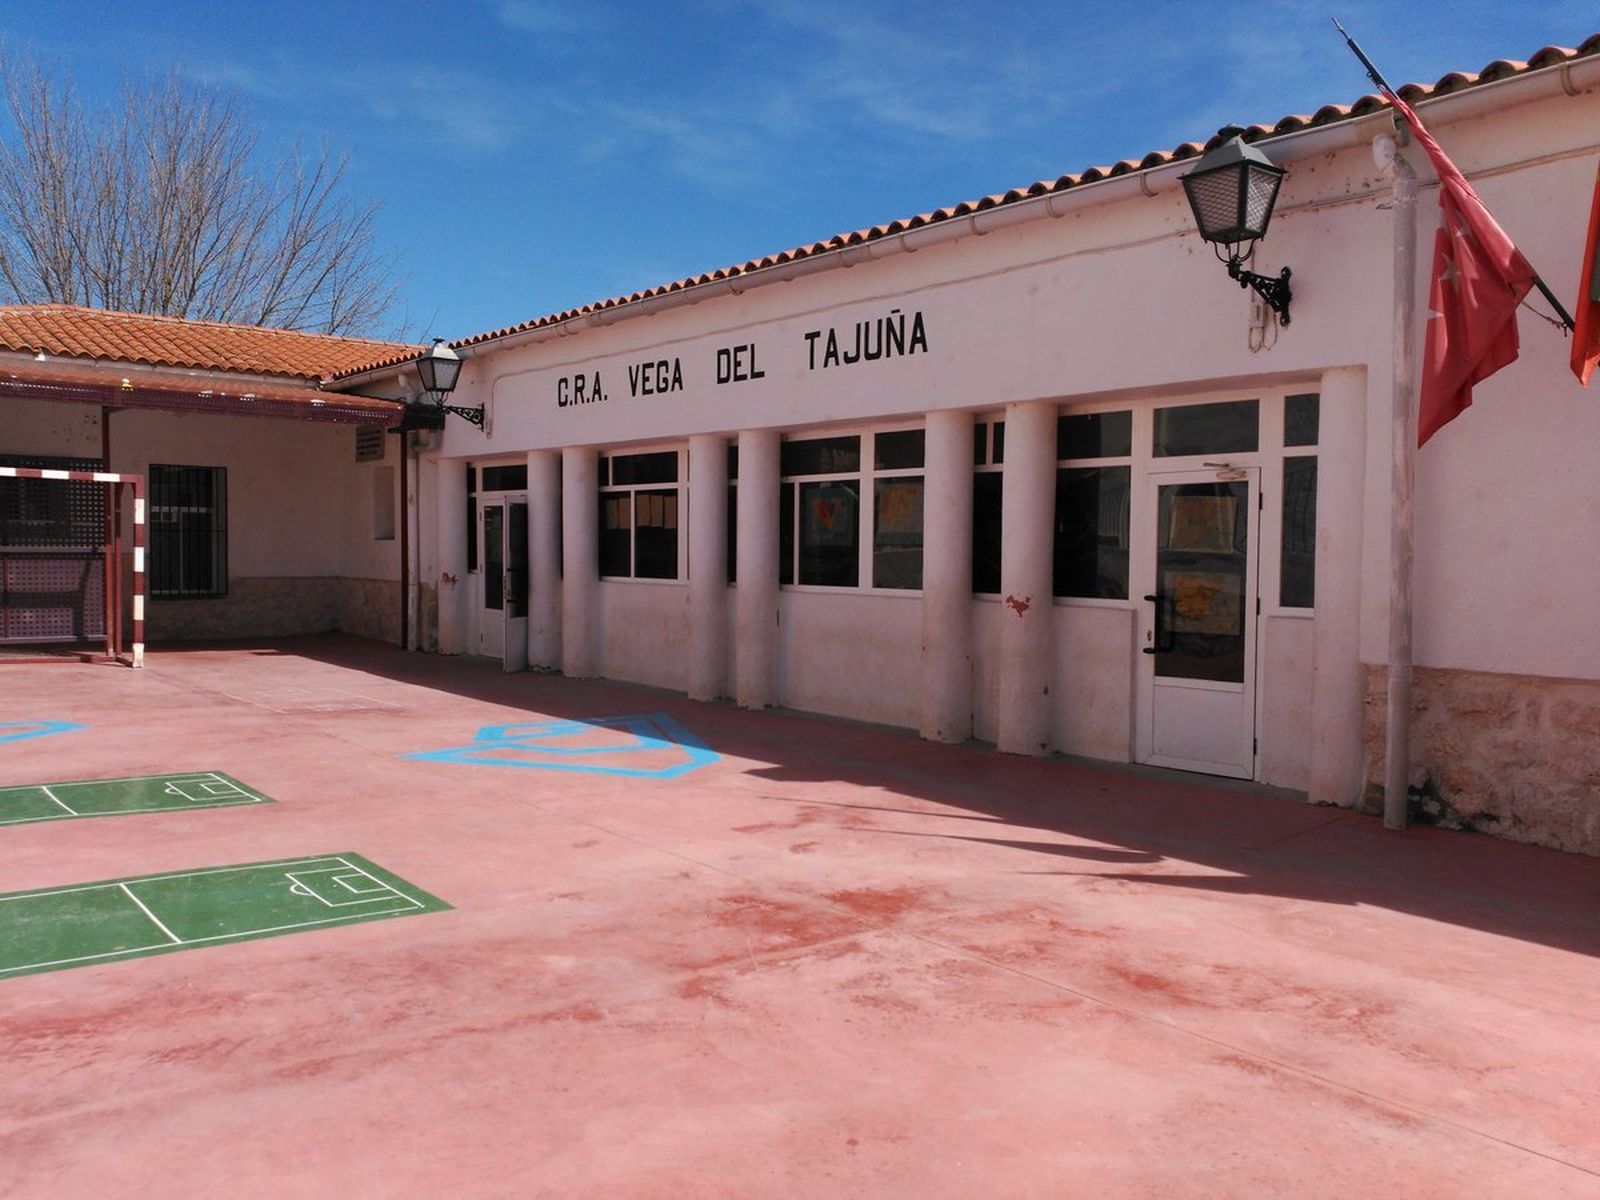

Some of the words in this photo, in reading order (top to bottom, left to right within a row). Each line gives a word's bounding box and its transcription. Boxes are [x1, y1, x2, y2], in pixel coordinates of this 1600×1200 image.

[557, 371, 608, 408] C.R.A.
[628, 357, 684, 398] VEGA
[716, 343, 765, 385] DEL
[804, 309, 929, 370] TAJUÑA
